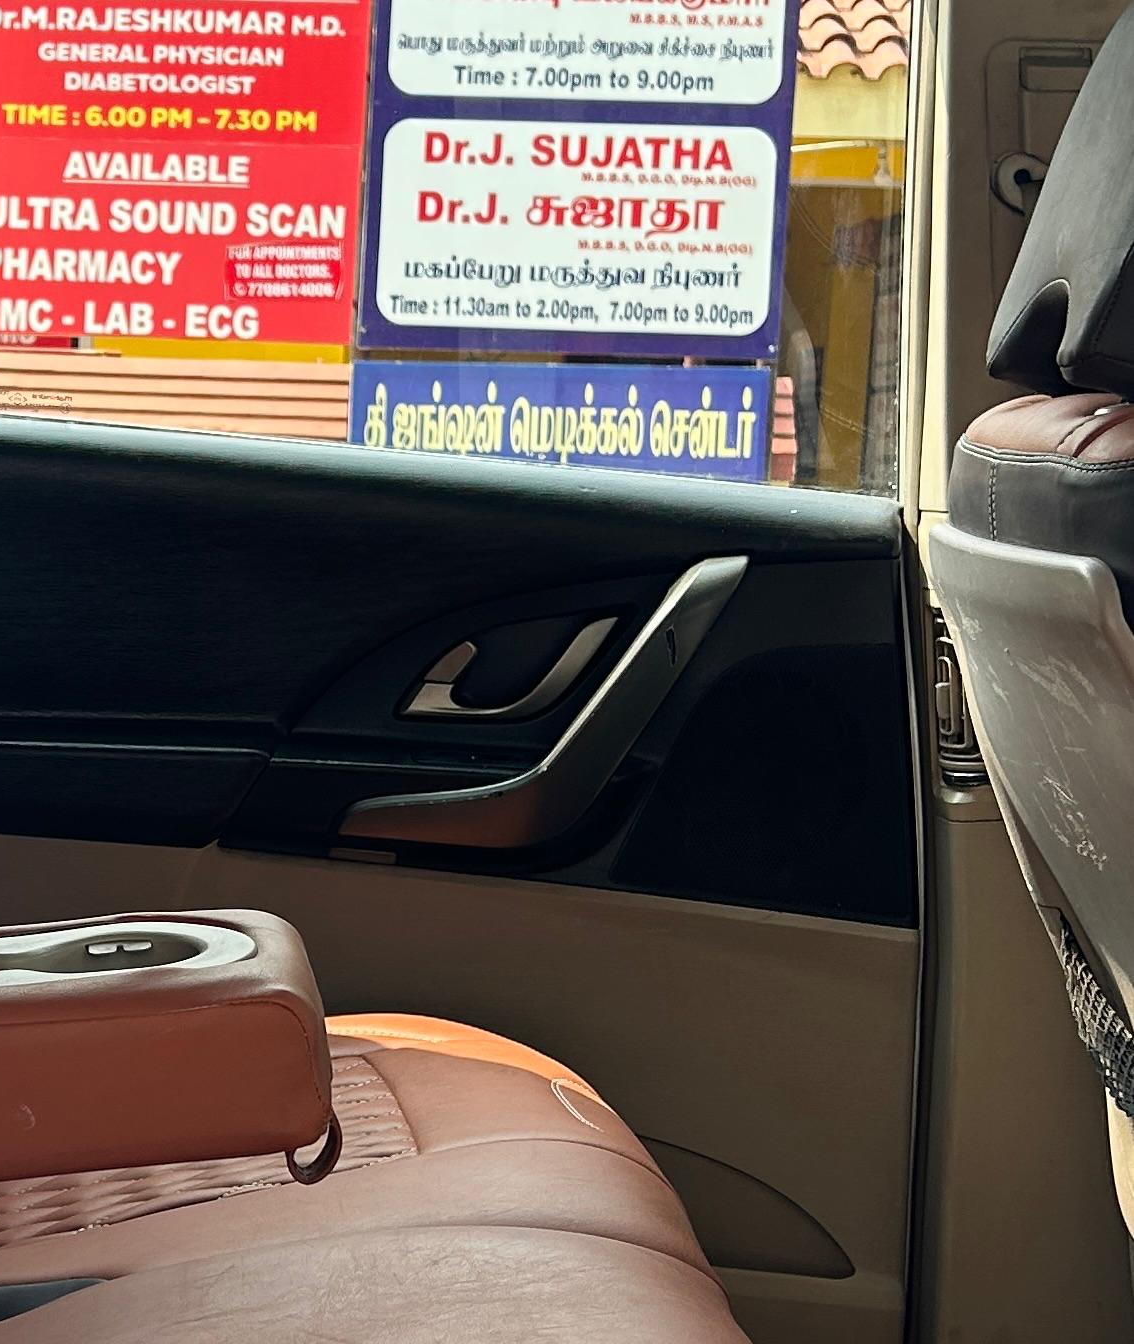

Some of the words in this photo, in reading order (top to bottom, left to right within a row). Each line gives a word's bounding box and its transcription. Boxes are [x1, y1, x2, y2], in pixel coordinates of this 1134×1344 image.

[290, 15, 346, 37] M.D.
[38, 42, 149, 64] GENERAL
[152, 44, 285, 67] PHYSICIAN
[64, 72, 256, 96] DIABETOLOGIST
[454, 65, 505, 86] Time
[525, 67, 601, 92] 7.00pm
[610, 70, 630, 89] to
[637, 70, 714, 95] 9.00pm
[1, 103, 68, 126] TIME
[84, 106, 147, 128] 6.00
[150, 107, 192, 129] PM
[214, 108, 271, 131] 7.30
[275, 111, 318, 132] PM
[63, 151, 250, 183] AVAILABLE
[424, 131, 514, 165] Dr.J.
[530, 134, 733, 171] SUJATHA
[108, 199, 237, 235] SOUND
[245, 203, 346, 239] SCAN
[417, 190, 509, 225] Dr.J.
[526, 195, 726, 239] சுஜாதா
[404, 256, 521, 288] மகப்பேறு
[529, 259, 645, 290] மருத்துவ
[651, 262, 742, 292] நிபுணர்
[83, 300, 154, 335] LAB
[184, 304, 259, 340] ECG
[391, 294, 428, 315] Time
[444, 296, 510, 318] 11.30am
[516, 298, 531, 317] to
[537, 299, 599, 324] 2.00pm,
[610, 301, 667, 326] 7.00pm
[674, 303, 689, 323] to
[695, 304, 754, 328] 9.00pm
[510, 383, 644, 464] மெடிக்கல்
[650, 385, 756, 459] சென்டர்
